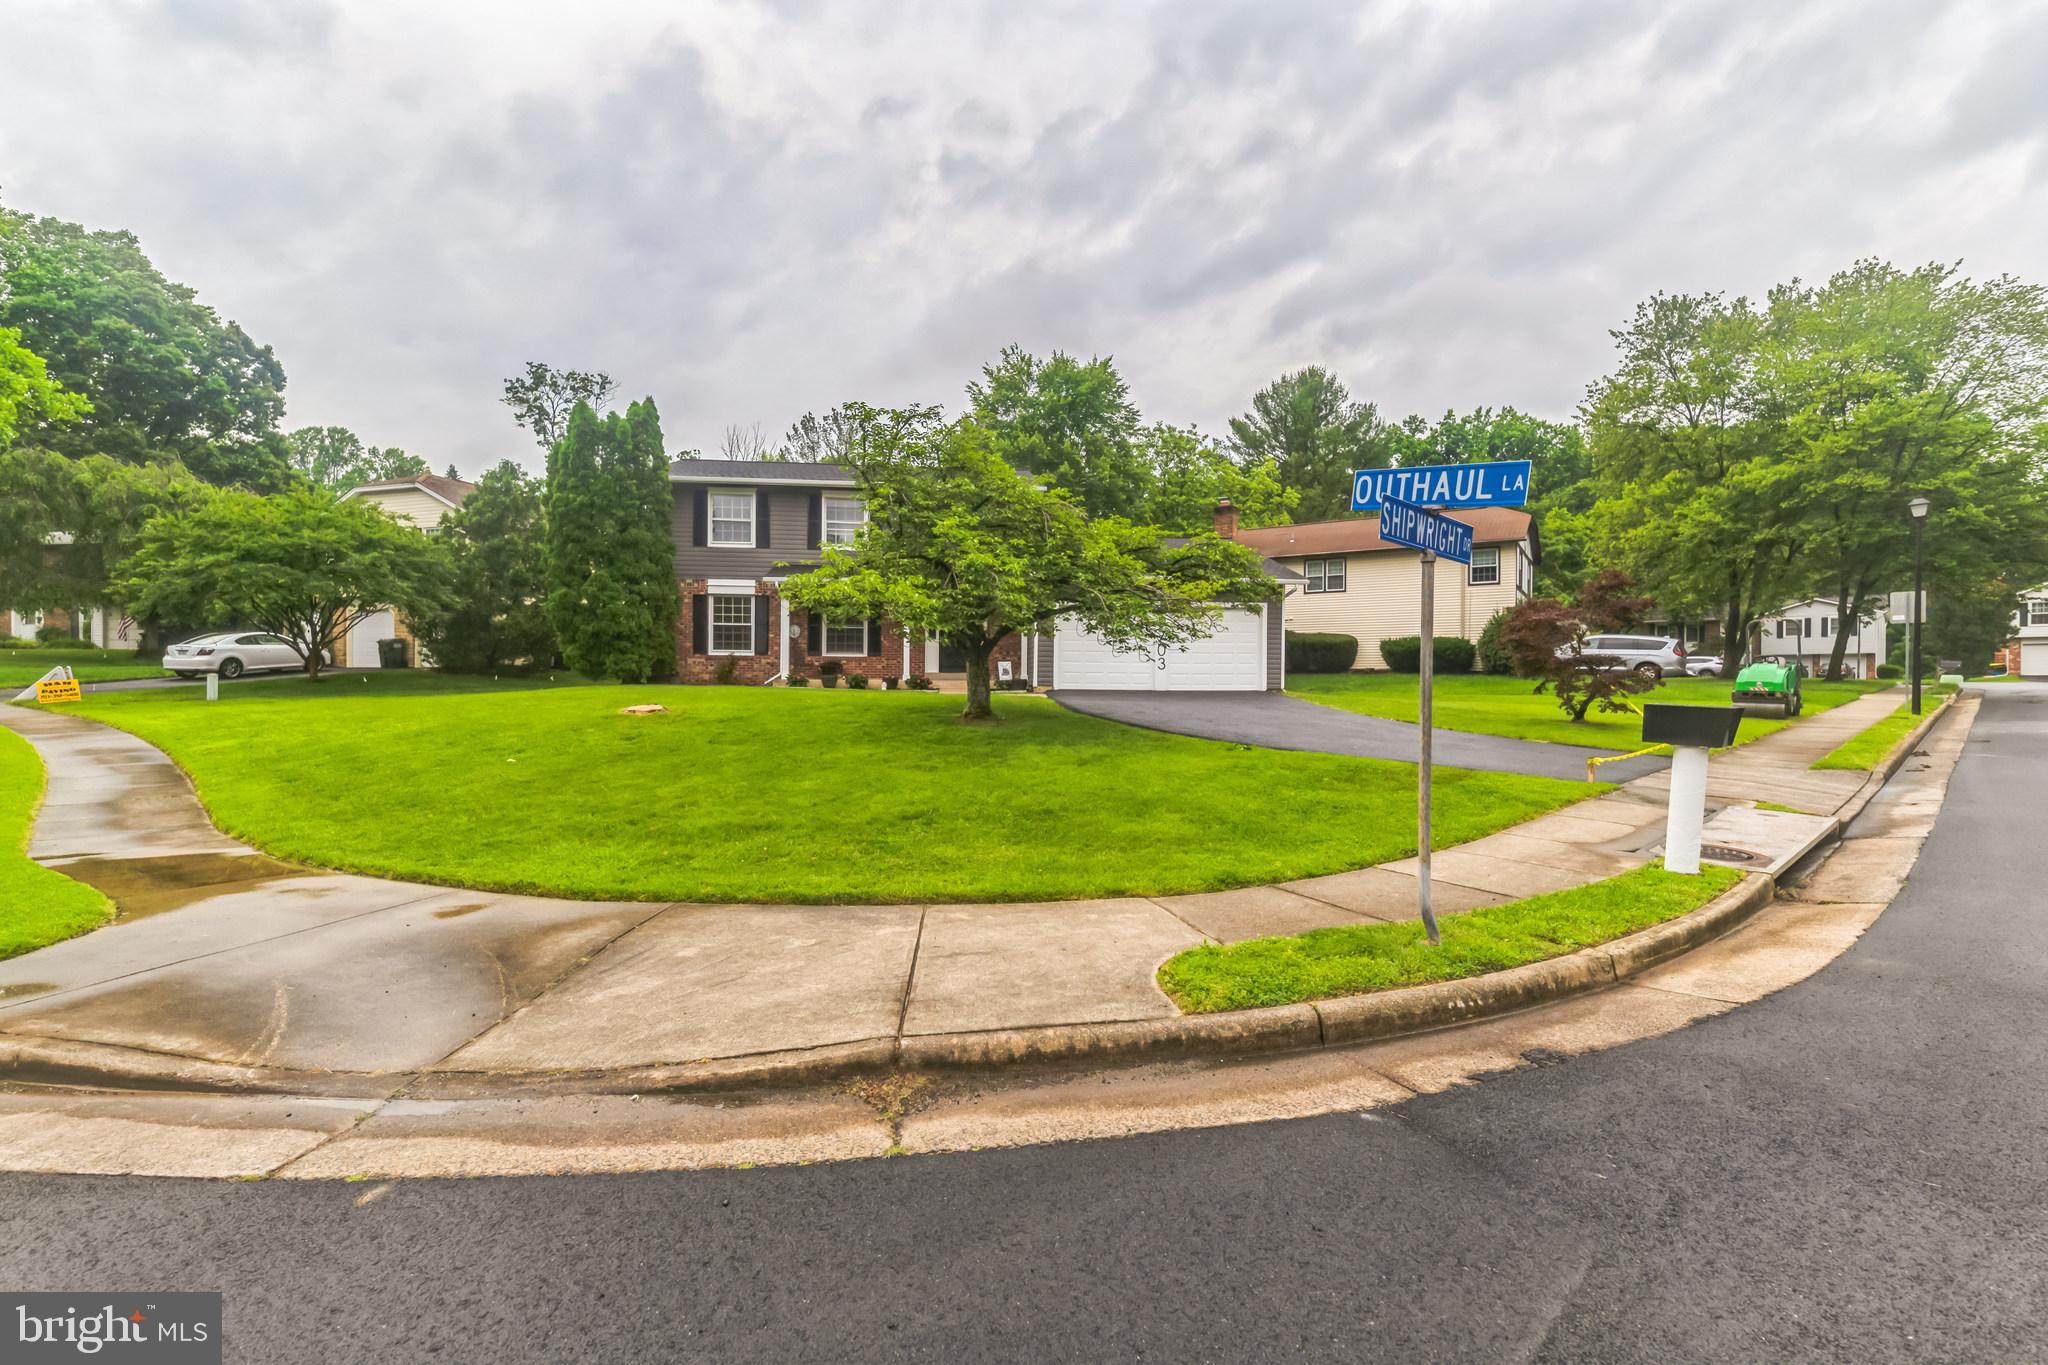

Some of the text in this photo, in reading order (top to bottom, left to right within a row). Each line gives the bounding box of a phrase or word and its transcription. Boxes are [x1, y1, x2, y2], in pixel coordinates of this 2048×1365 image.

[1355, 469, 1524, 504] OUTHAUL LA
[1381, 502, 1471, 556] SHIPWRIGHT DR
